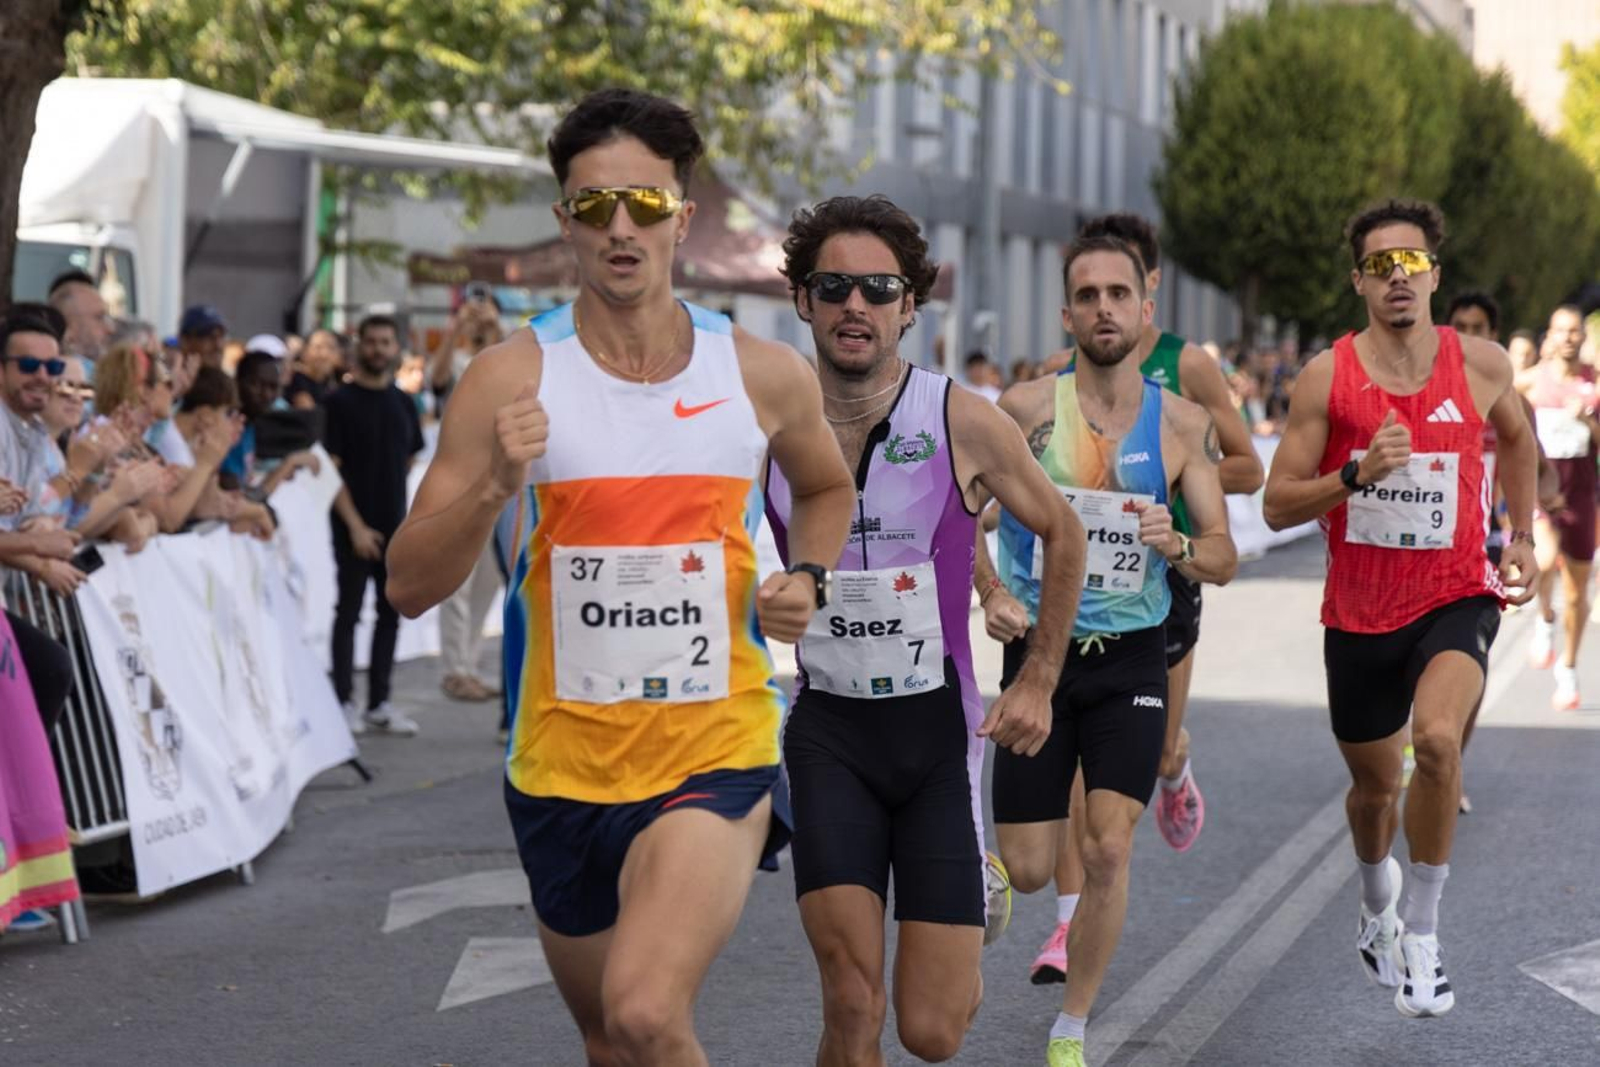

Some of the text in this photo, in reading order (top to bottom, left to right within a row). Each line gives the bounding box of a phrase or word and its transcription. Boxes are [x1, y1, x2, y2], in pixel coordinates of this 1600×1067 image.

[1119, 452, 1150, 465] HOKA
[1363, 483, 1443, 503] Pereira
[1431, 510, 1443, 529] 9
[877, 532, 916, 542] ALBACETE
[570, 556, 605, 581] 37
[1112, 551, 1141, 572] 22
[580, 600, 703, 628] Oriach
[829, 615, 903, 638] Saez
[691, 635, 710, 667] 2
[908, 640, 925, 666] 7
[1132, 695, 1164, 709] HOKA
